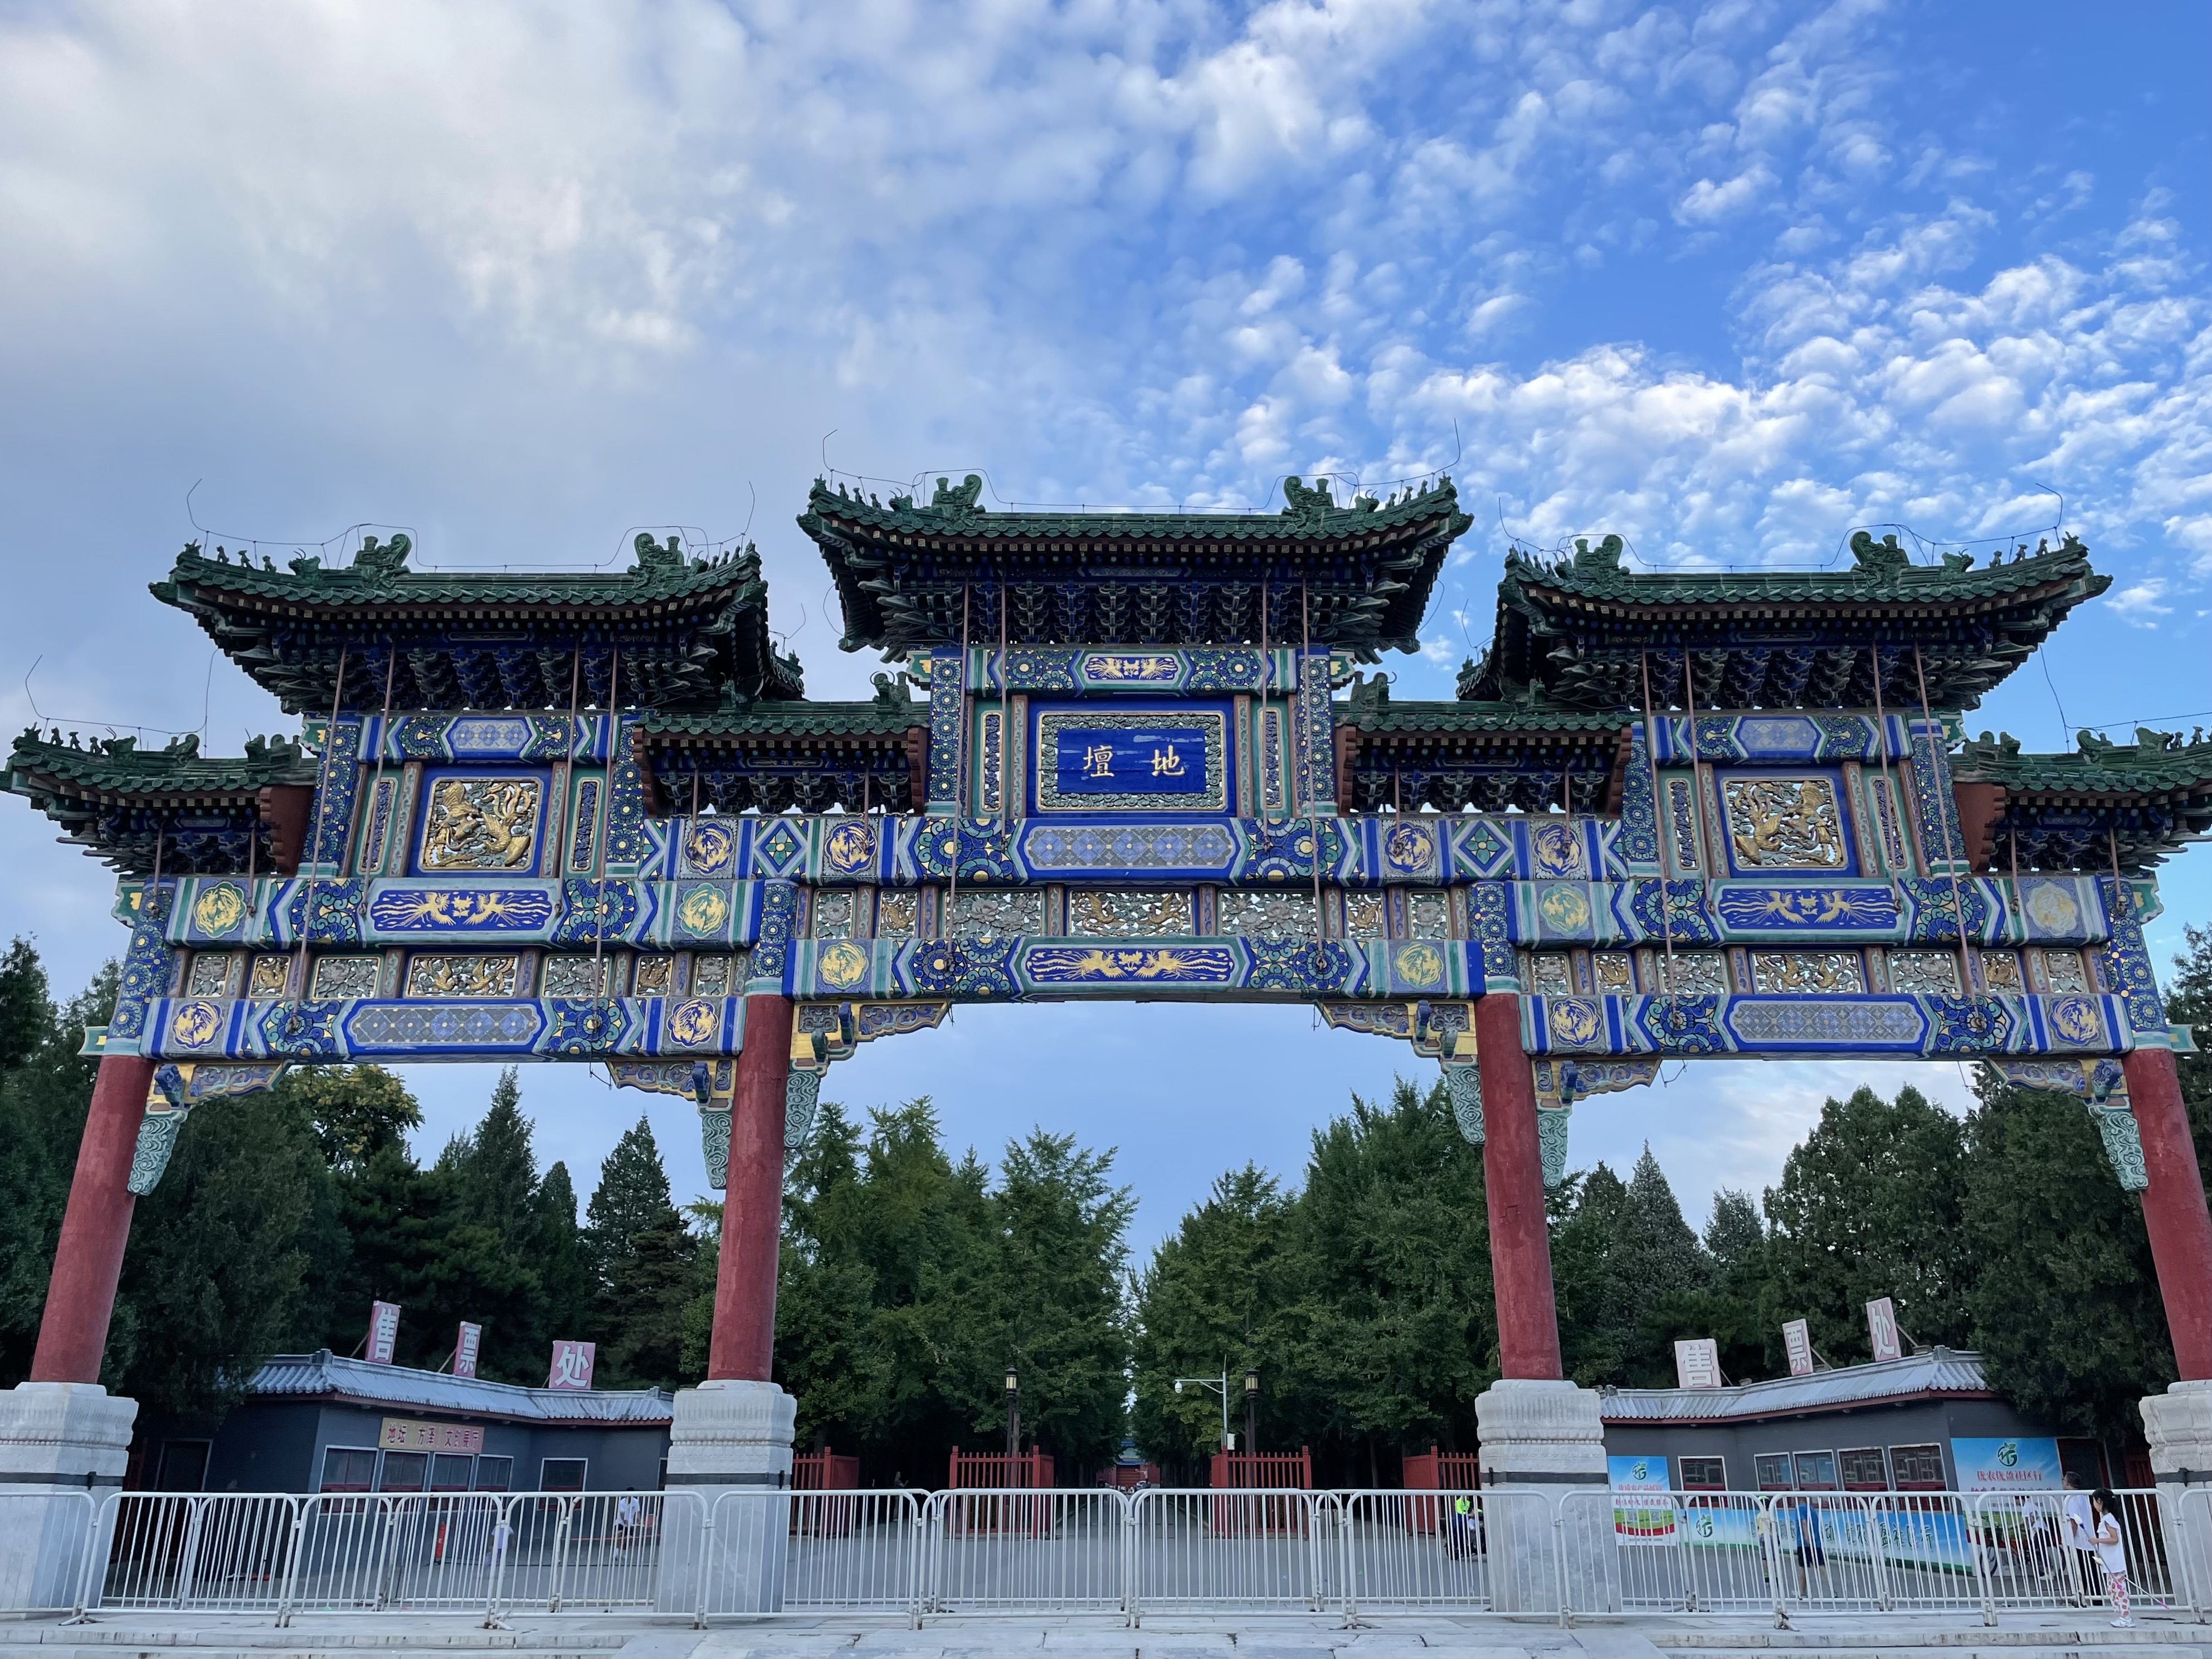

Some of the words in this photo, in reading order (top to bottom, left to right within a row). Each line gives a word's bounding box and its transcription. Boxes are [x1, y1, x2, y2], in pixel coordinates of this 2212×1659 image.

[374, 1307, 398, 1360] 售
[460, 1326, 480, 1373] 票
[556, 1345, 590, 1388] 处
[1682, 1344, 1714, 1386] 售
[1785, 1326, 1808, 1371] 票
[1872, 1305, 1896, 1358] 处
[387, 1422, 407, 1444] 地坛
[417, 1426, 436, 1446] 方泽
[445, 1428, 480, 1450] 文创展厅
[1977, 1470, 2042, 1481] 优农优盈社区行
